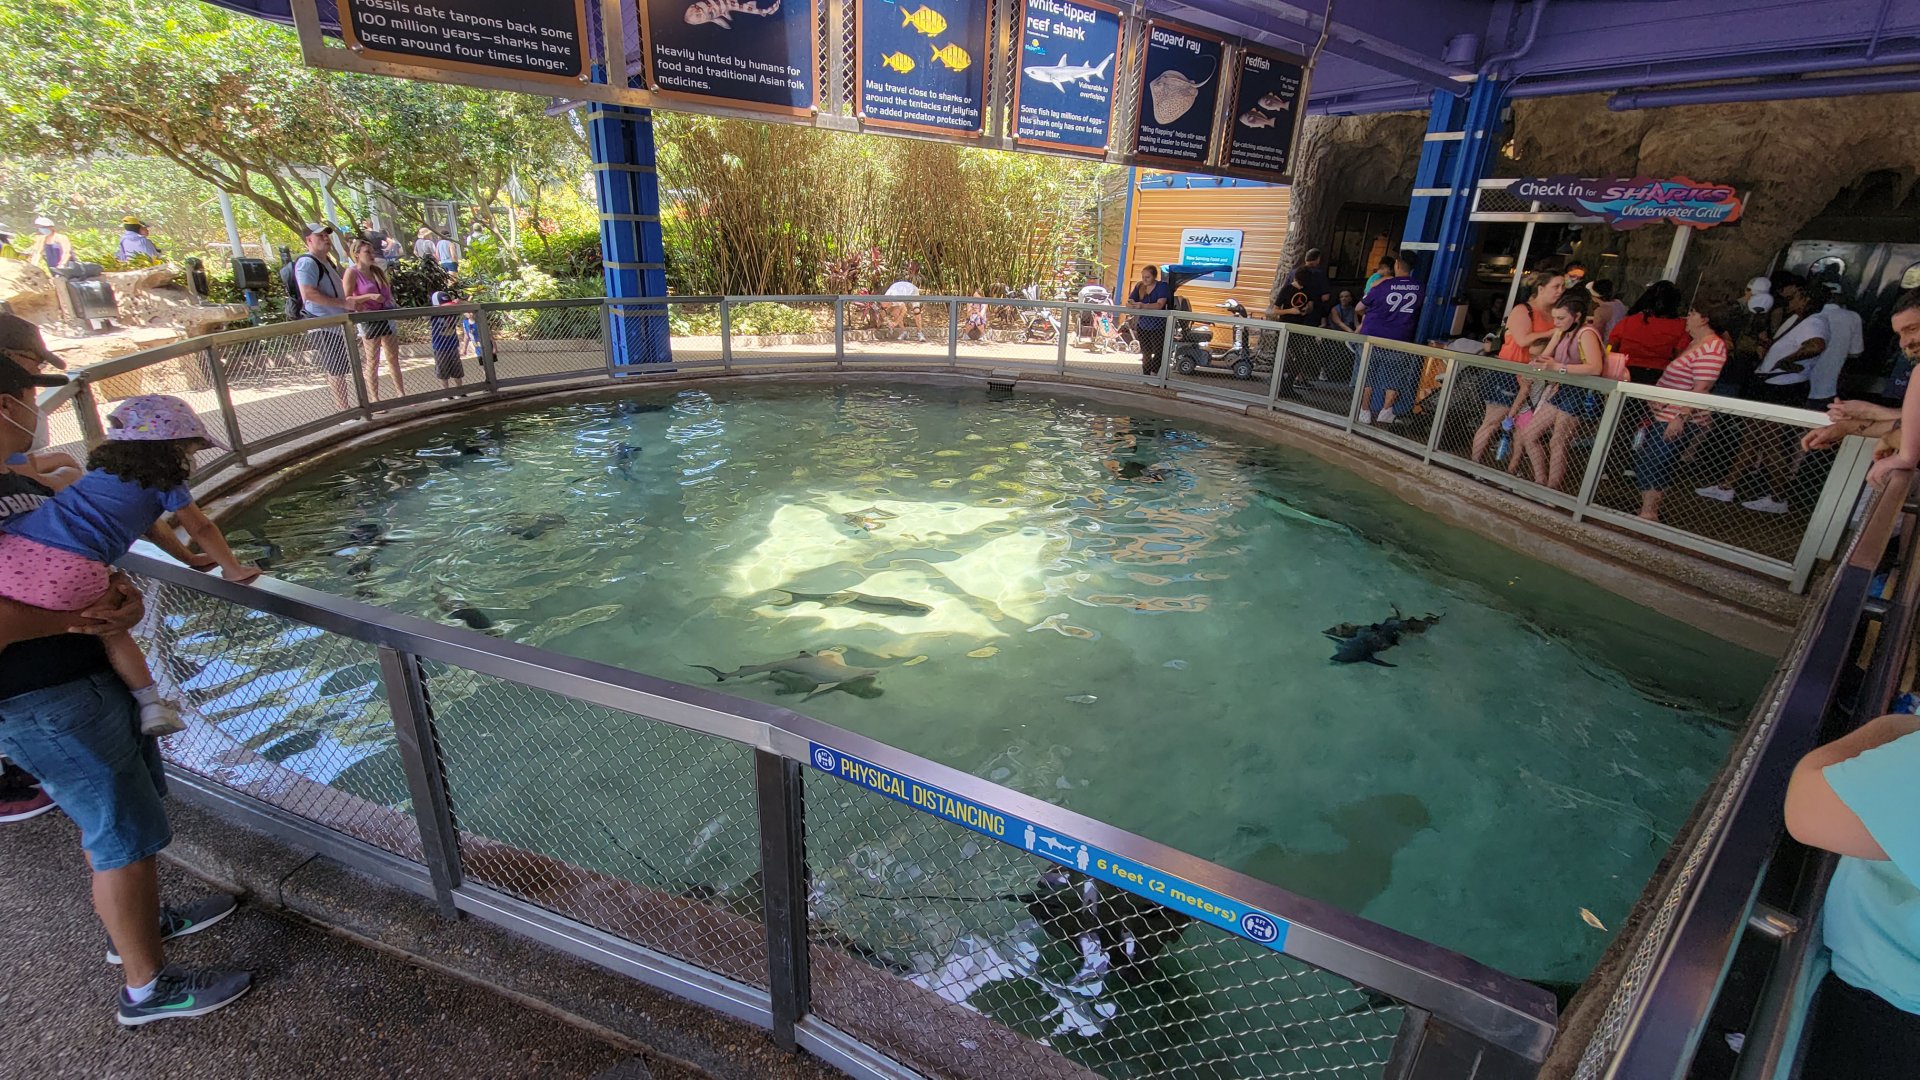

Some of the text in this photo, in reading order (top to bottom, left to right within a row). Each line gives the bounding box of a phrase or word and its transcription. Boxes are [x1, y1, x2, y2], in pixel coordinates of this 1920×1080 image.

[414, 4, 446, 19] date
[449, 10, 503, 28] tarpons
[506, 19, 537, 34] back
[541, 27, 573, 40] some
[1027, 17, 1050, 32] reef
[1053, 22, 1086, 40] shark
[358, 12, 386, 26] 100
[391, 19, 438, 35] million
[542, 41, 571, 56] have
[1152, 27, 1185, 48] leopard
[1186, 40, 1201, 54] ray
[361, 30, 568, 70] been around four times longer.
[656, 44, 800, 76] Heavily hunted by humans for
[1246, 56, 1270, 70] redfish
[657, 59, 804, 90] food and traditional Asian folk
[659, 76, 711, 90] medicines.
[866, 80, 883, 92] May
[885, 82, 907, 94] travel
[909, 88, 928, 97] close
[929, 90, 937, 99] to
[939, 92, 962, 103] sharks
[1079, 81, 1102, 92] Vulnerable
[1080, 91, 1106, 102] overfishing
[866, 94, 893, 104] around
[895, 96, 907, 106] the
[909, 99, 941, 111] tentacles
[952, 106, 978, 117] jellyfish
[866, 105, 973, 127] for added predator protection.
[1021, 105, 1037, 114] Some
[1039, 108, 1049, 116] fish
[1051, 110, 1059, 119] lay
[1061, 112, 1082, 121] millions
[1019, 128, 1034, 136] pups
[1035, 129, 1044, 137] per
[1021, 116, 1032, 124] this
[1033, 118, 1050, 126] shark
[1051, 121, 1063, 129] only
[1064, 122, 1074, 130] has
[1093, 127, 1103, 135] five
[1520, 182, 1566, 196] Check
[1568, 183, 1583, 196] in
[1602, 182, 1730, 203] SHARKS
[1622, 206, 1722, 218] Underwater Grill
[1187, 234, 1235, 244] SHARKS
[1386, 292, 1418, 313] 92
[840, 758, 1005, 836] PHYSICAL DISTANCING
[1097, 859, 1237, 923] 6 feet (2 meters)
